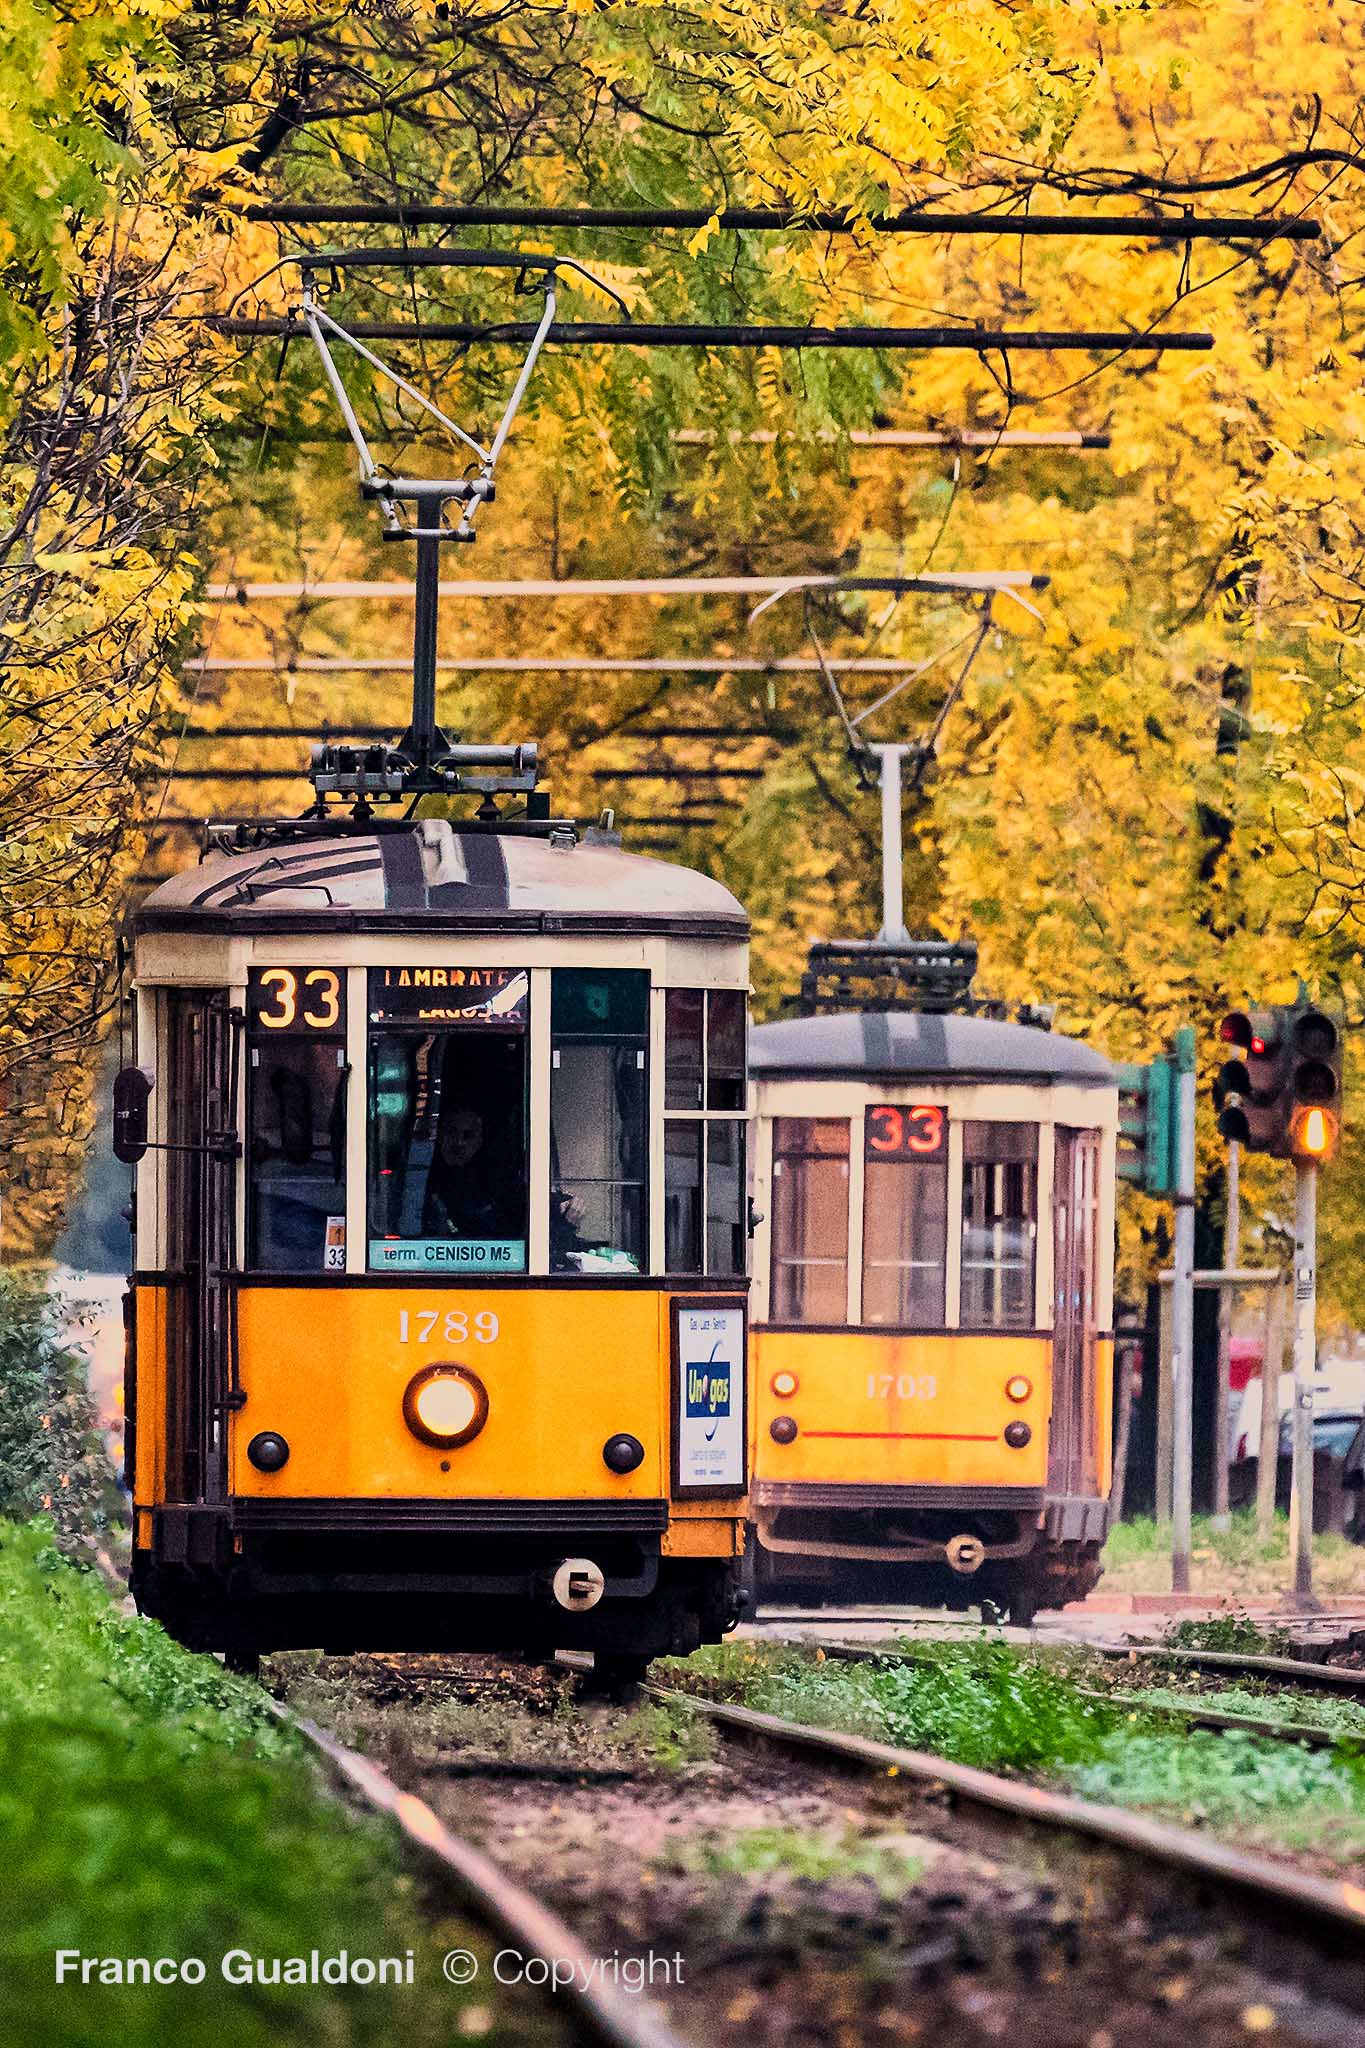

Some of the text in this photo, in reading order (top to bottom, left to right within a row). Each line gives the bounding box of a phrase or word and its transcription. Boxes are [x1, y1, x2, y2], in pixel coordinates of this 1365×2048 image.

[258, 968, 341, 1028] 33
[870, 1104, 944, 1153] 33
[328, 1248, 345, 1266] 33
[384, 1246, 512, 1261] term. CENISIO M5
[399, 1310, 499, 1344] 1789
[866, 1375, 938, 1400] 1703
